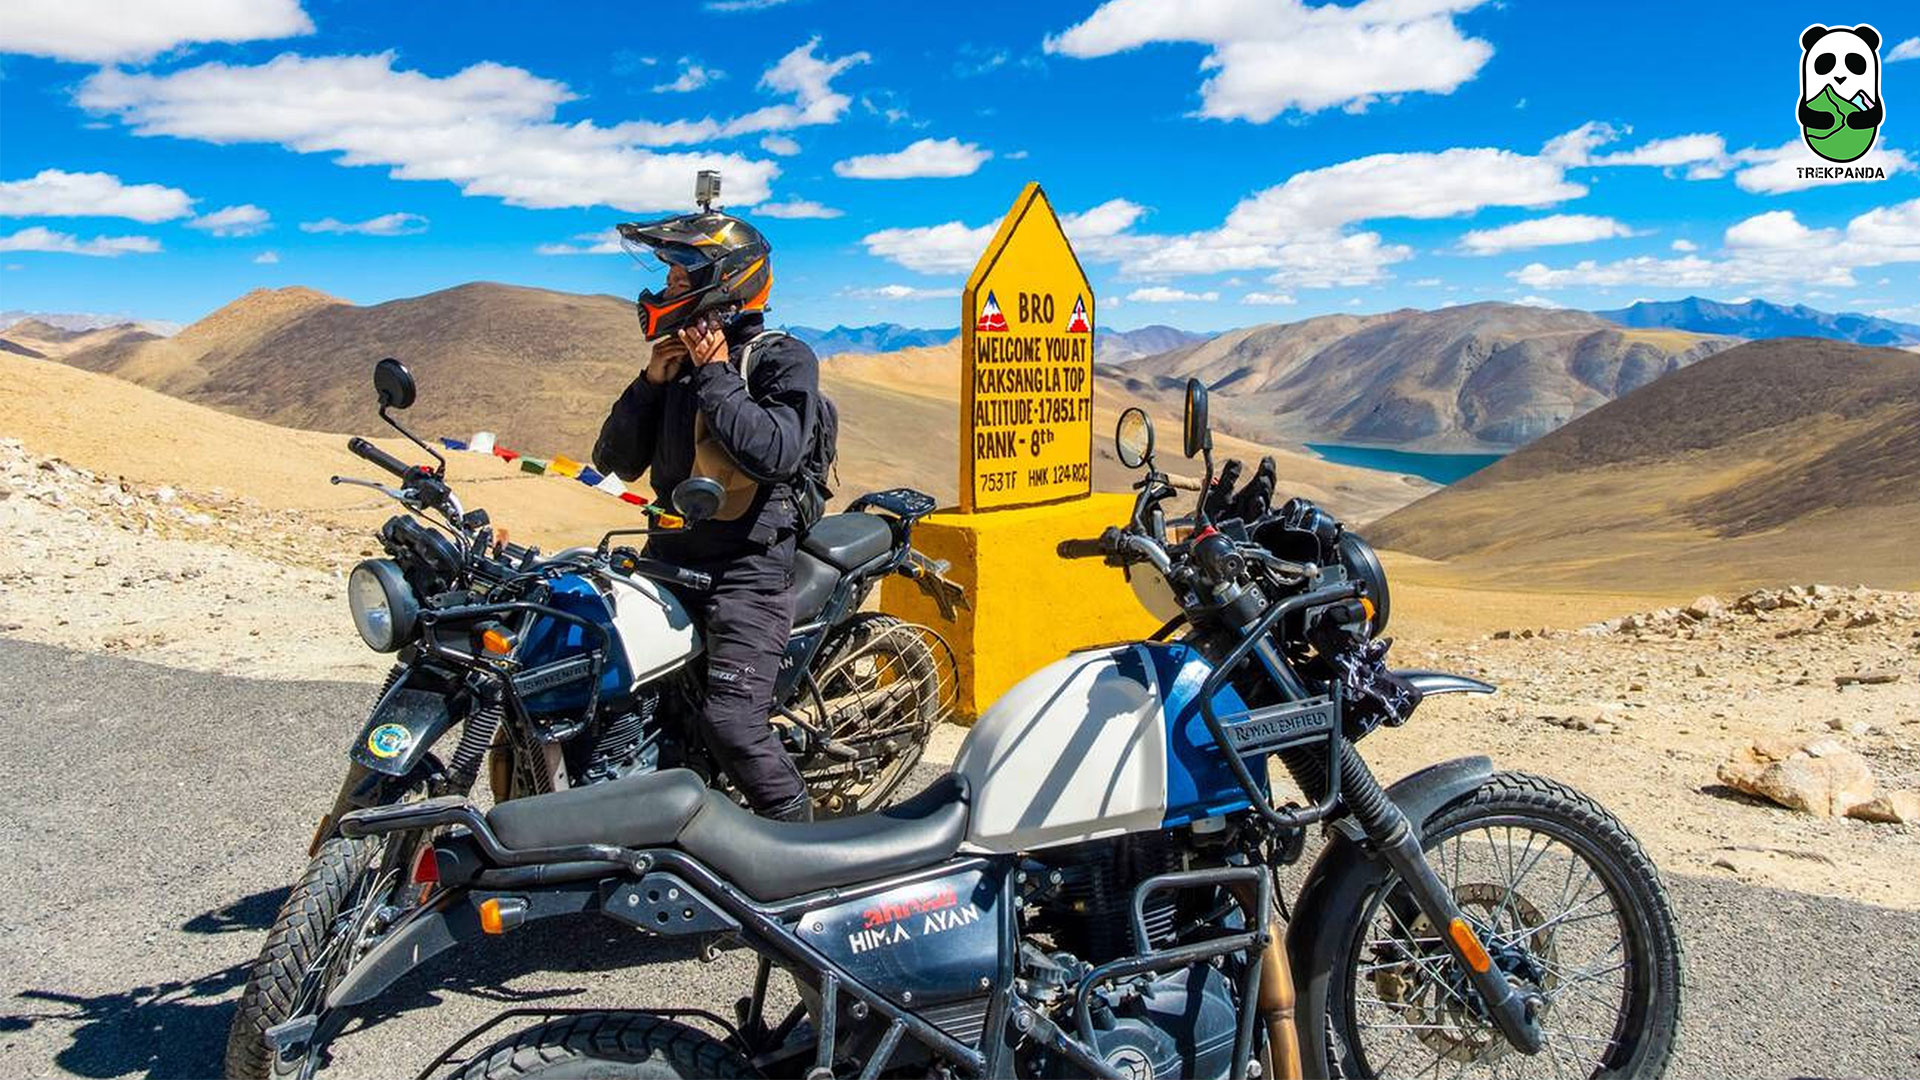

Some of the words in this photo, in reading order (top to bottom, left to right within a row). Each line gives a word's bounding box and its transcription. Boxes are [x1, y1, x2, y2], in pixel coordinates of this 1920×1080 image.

[1018, 292, 1054, 323] BRO
[977, 337, 1041, 363] WELCOME
[1046, 338, 1070, 363] YOU
[1071, 338, 1086, 362] AT
[977, 367, 1042, 394] KAKSANG
[1044, 367, 1061, 392] LA
[1063, 367, 1085, 392] TOP
[1077, 398, 1090, 421] FT
[977, 431, 1017, 460] RANK
[1030, 428, 1054, 457] 8th
[980, 472, 1004, 492] 753
[1005, 470, 1018, 489] TF
[1028, 467, 1049, 487] HMK
[1053, 464, 1072, 485] 124
[1235, 723, 1278, 741] ROYAL
[1279, 712, 1327, 734] ENFIELD
